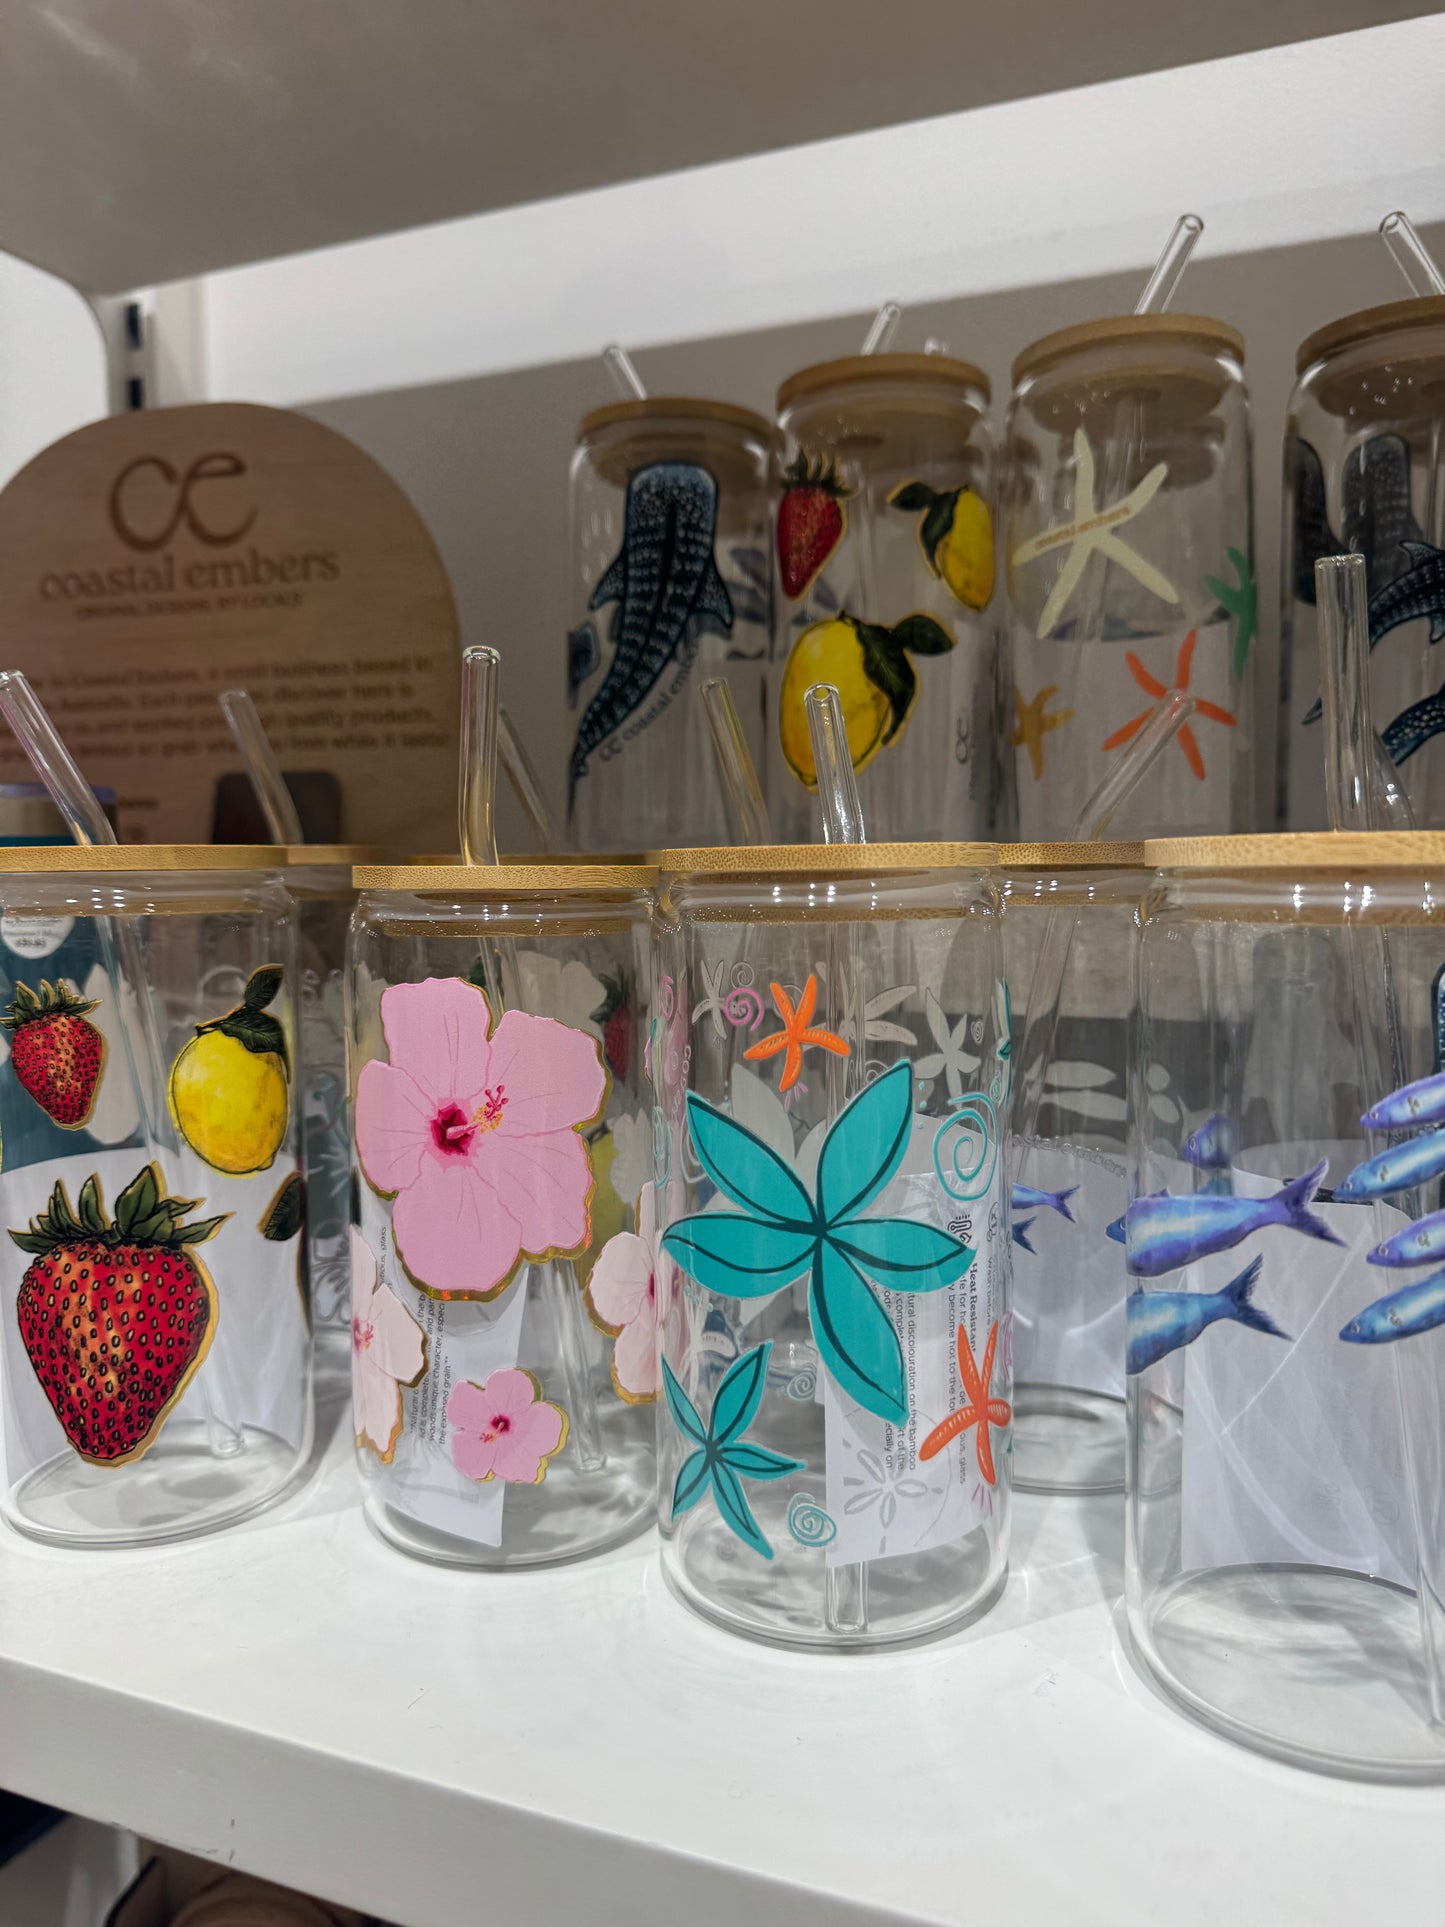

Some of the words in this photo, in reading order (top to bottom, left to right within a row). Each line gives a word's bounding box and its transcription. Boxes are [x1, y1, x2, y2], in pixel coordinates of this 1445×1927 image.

[39, 554, 177, 601] coastal
[183, 547, 341, 590] embers
[949, 1294, 957, 1338] become
[907, 1320, 918, 1391] discolouration
[949, 1341, 957, 1360] hot
[949, 1376, 957, 1394] the
[908, 1428, 917, 1470] bamboo
